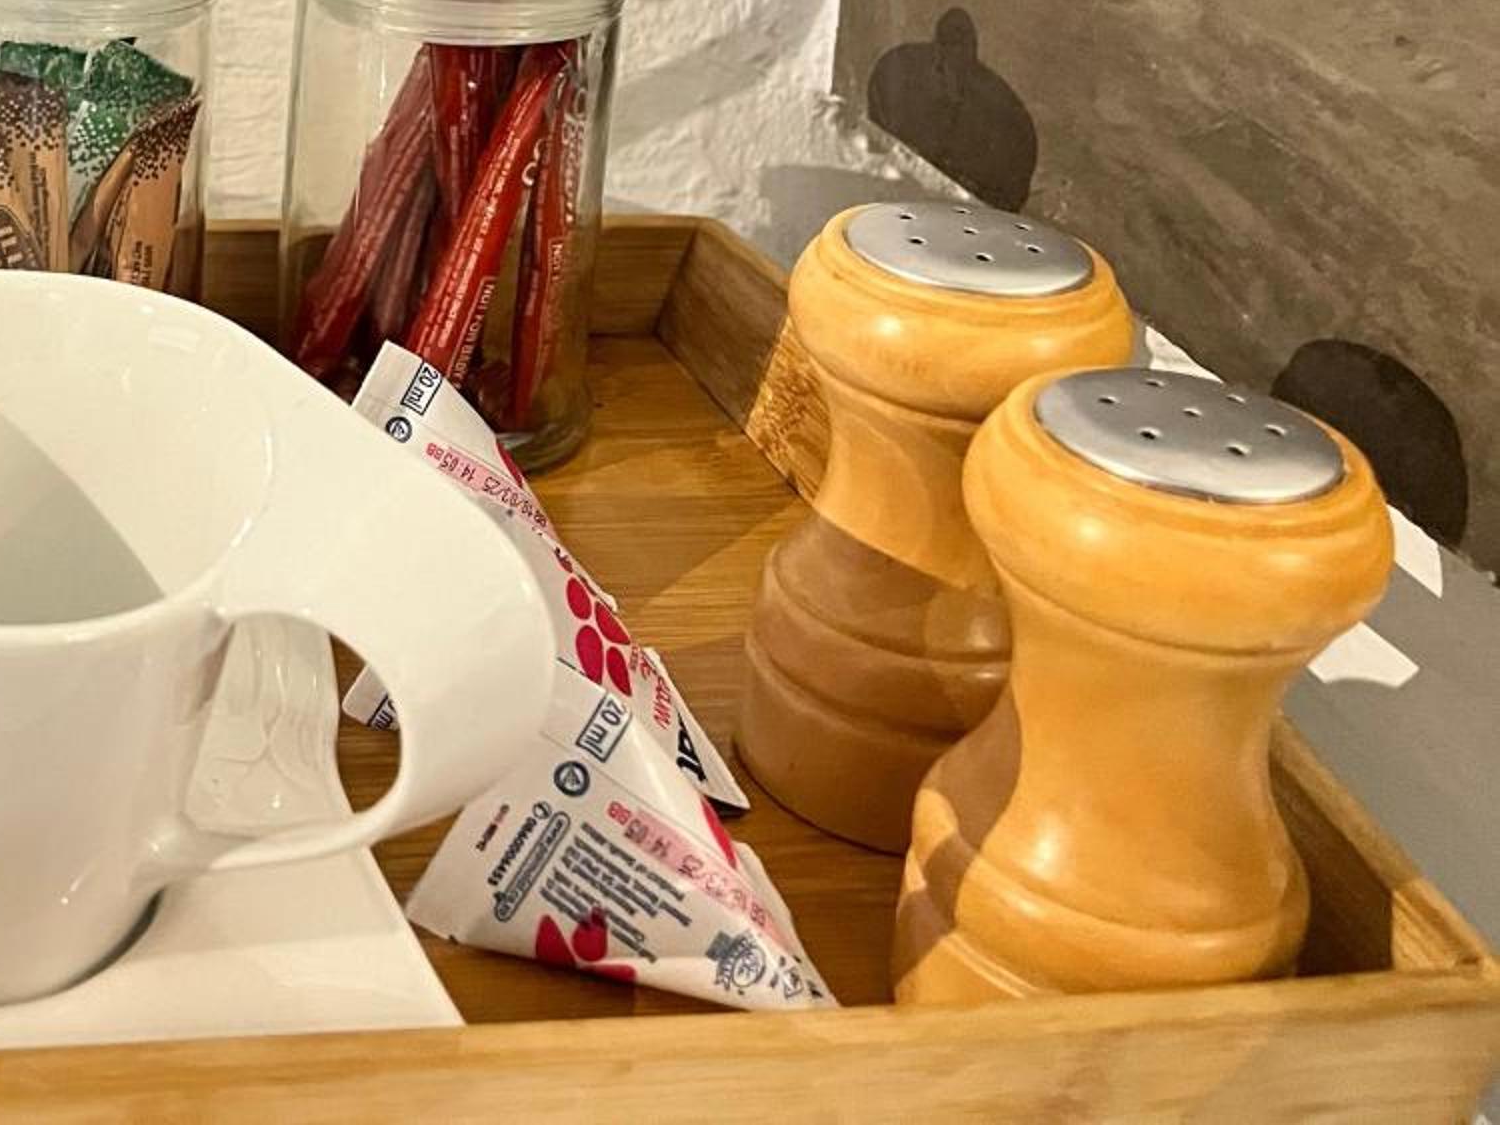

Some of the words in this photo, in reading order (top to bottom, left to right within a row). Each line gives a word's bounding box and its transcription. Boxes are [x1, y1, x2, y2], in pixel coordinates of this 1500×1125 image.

[419, 366, 439, 389] 20
[406, 386, 427, 410] ml
[601, 699, 626, 726] 20
[583, 723, 608, 754] ml
